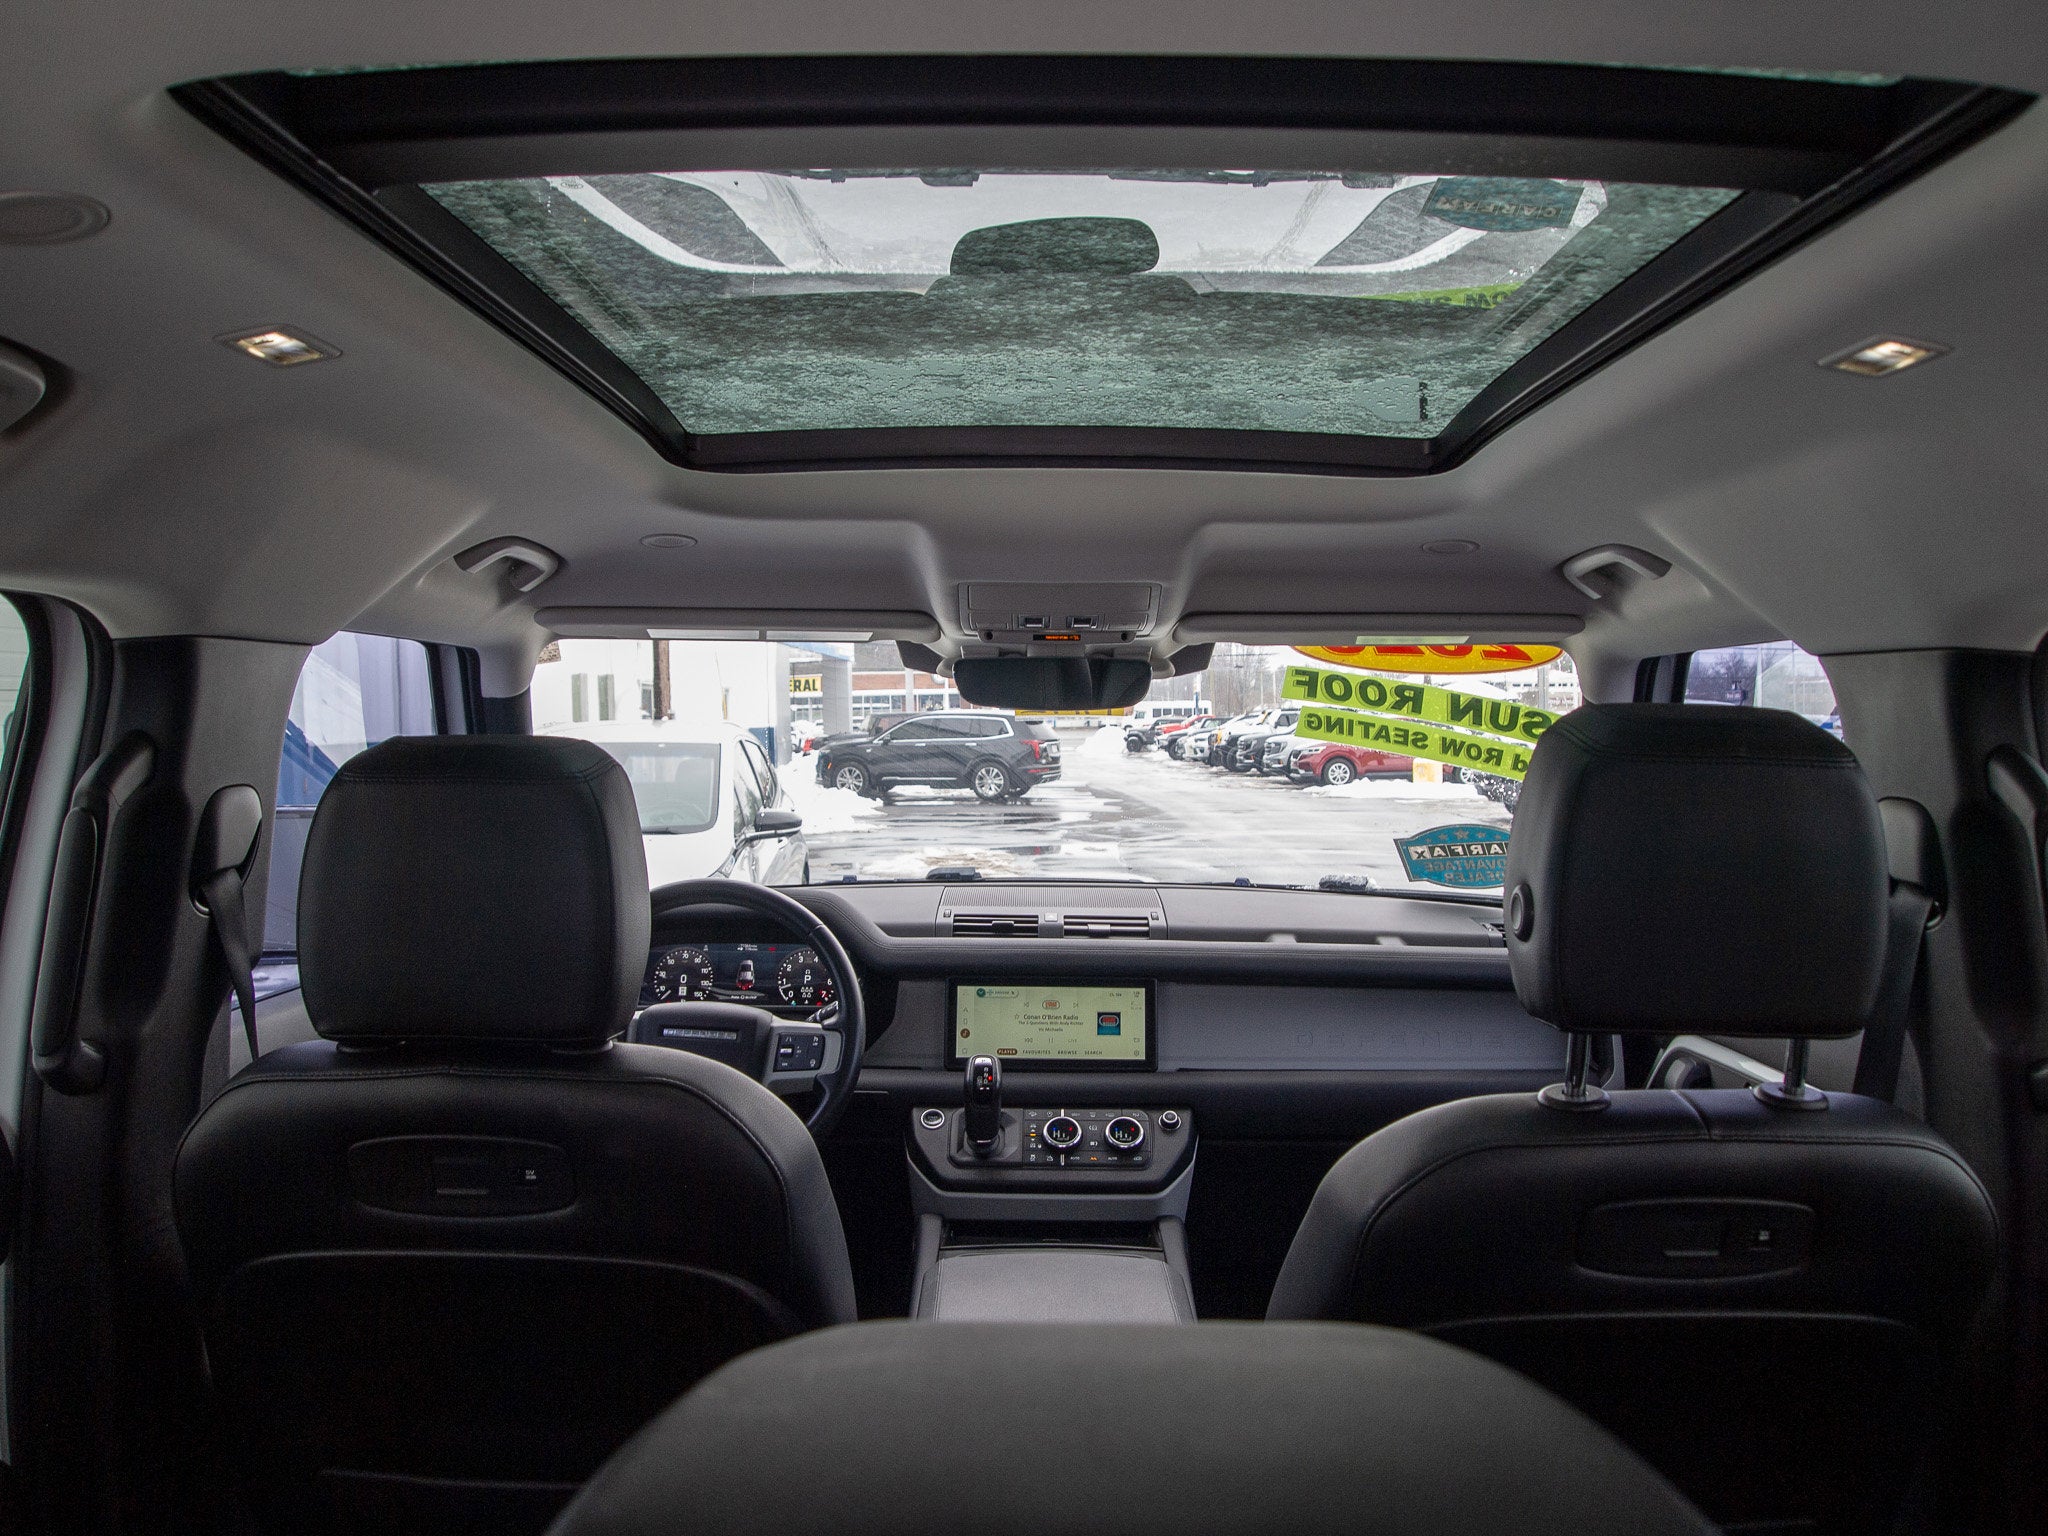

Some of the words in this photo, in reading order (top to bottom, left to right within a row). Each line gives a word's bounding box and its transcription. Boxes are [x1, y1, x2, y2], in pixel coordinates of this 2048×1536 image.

[680, 974, 687, 984] 0
[804, 975, 811, 984] P
[788, 990, 794, 998] 0
